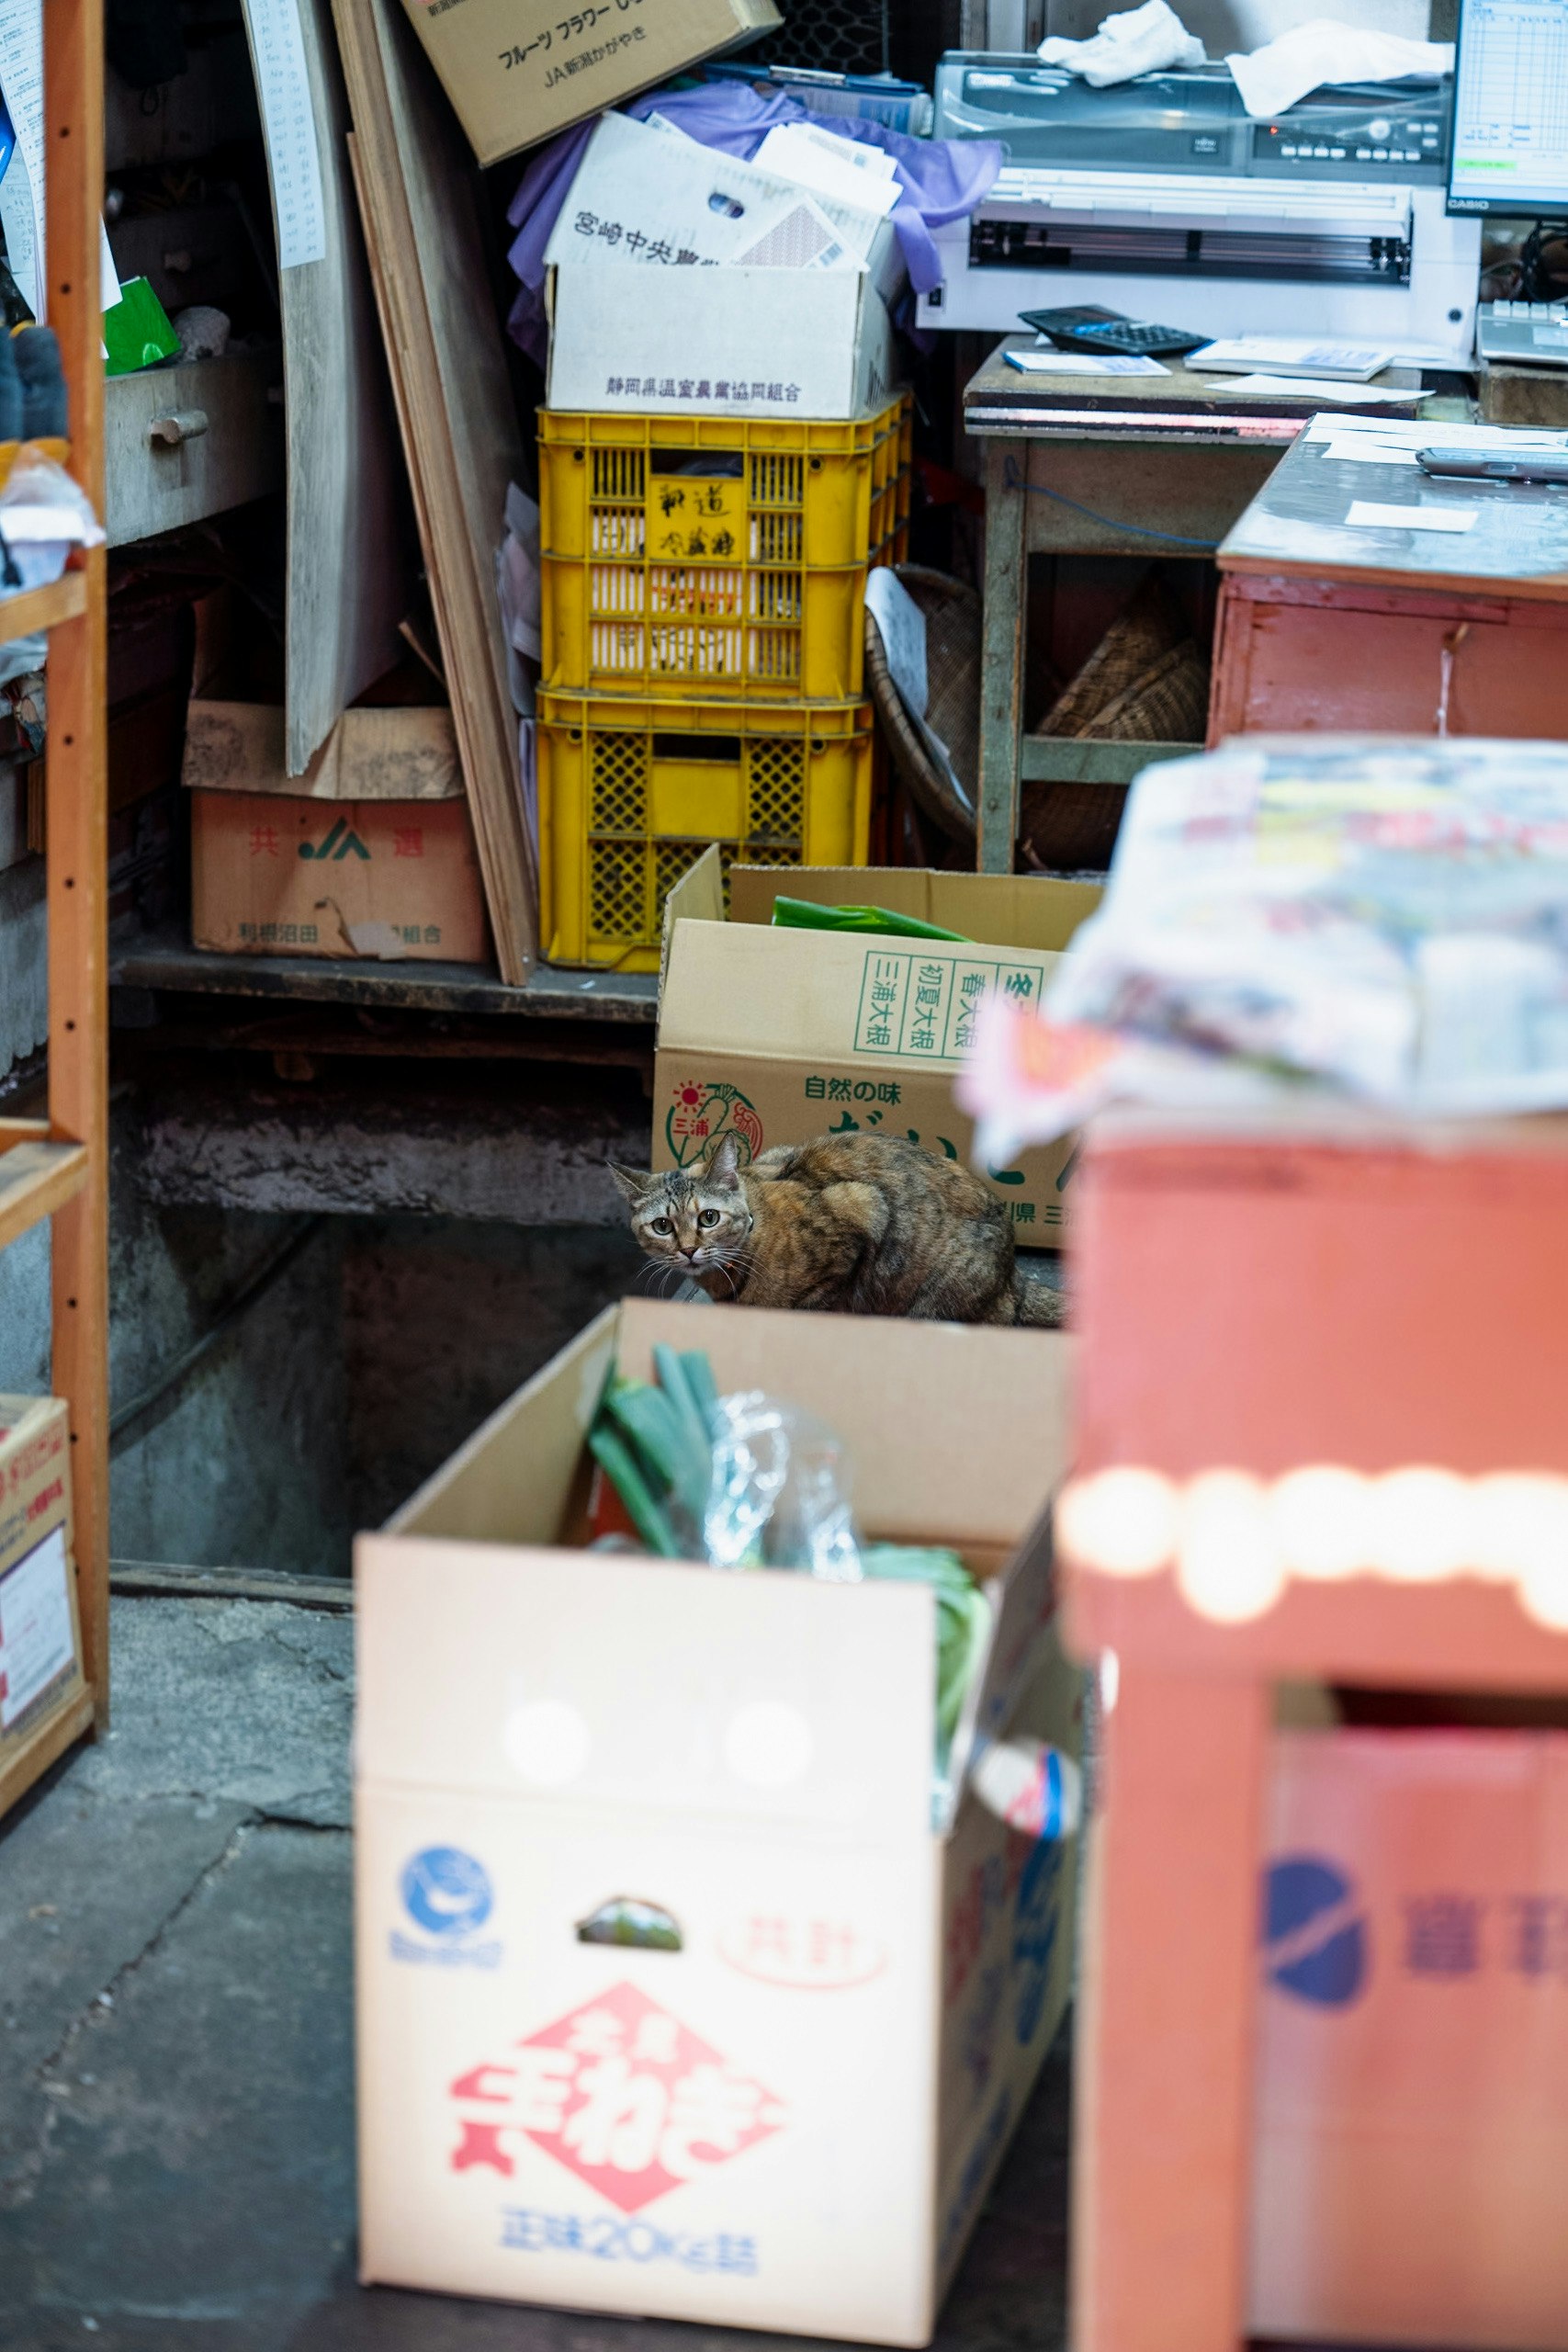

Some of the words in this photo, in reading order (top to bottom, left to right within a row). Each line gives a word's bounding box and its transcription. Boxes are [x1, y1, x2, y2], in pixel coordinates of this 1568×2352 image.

[498, 30, 553, 70] フルーツ
[556, 6, 610, 40] フラワー
[544, 25, 647, 88] JA新潟かがやき
[1448, 199, 1489, 209] CASIO
[574, 211, 719, 266] 宮崎中央農
[605, 377, 801, 402] 静岡県温室農業協同組合
[250, 827, 279, 857] 共
[865, 958, 900, 1046] 三浦大根
[909, 963, 944, 1050] 初夏大根
[805, 1075, 902, 1106] 自然の味
[672, 1117, 710, 1137] 三浦
[446, 2045, 786, 2185] 玉ねぎ
